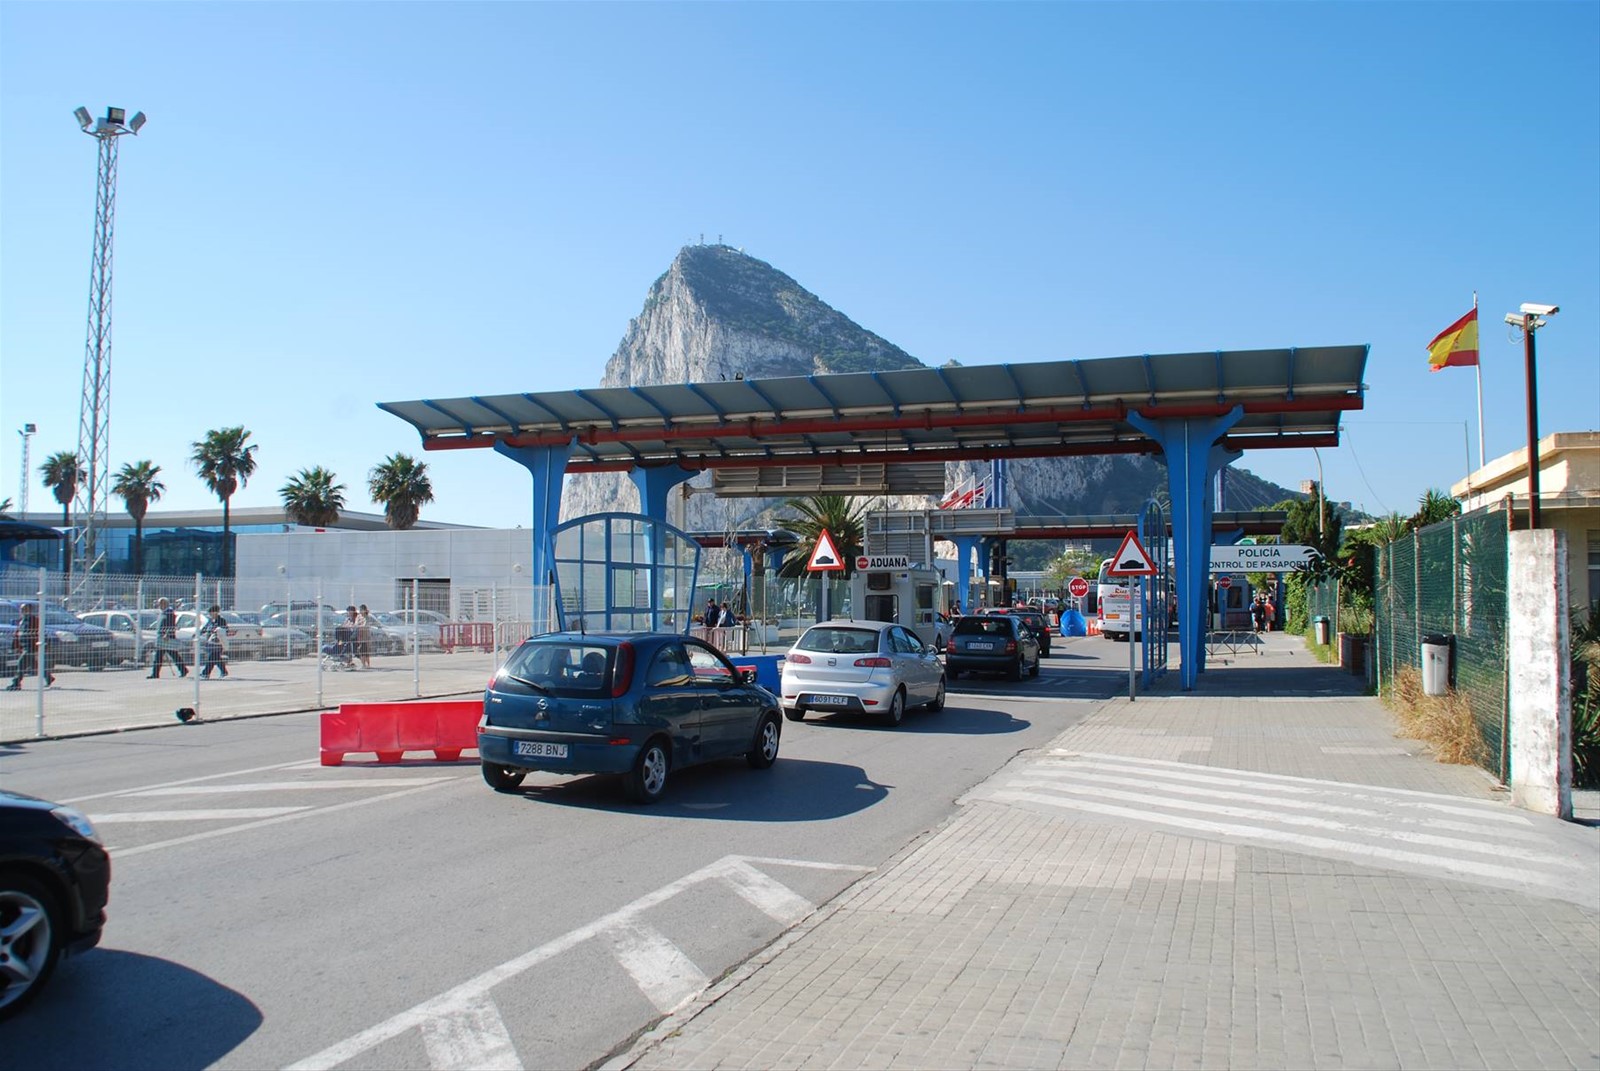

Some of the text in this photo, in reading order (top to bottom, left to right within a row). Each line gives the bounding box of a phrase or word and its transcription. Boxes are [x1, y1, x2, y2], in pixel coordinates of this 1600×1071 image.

[1238, 547, 1281, 558] POLICÍA
[870, 557, 908, 568] ADUANA
[1246, 561, 1259, 569] DE
[1260, 560, 1308, 568] PASAPORT
[814, 695, 831, 703] 6091
[520, 742, 565, 756] 7288 BNJ
